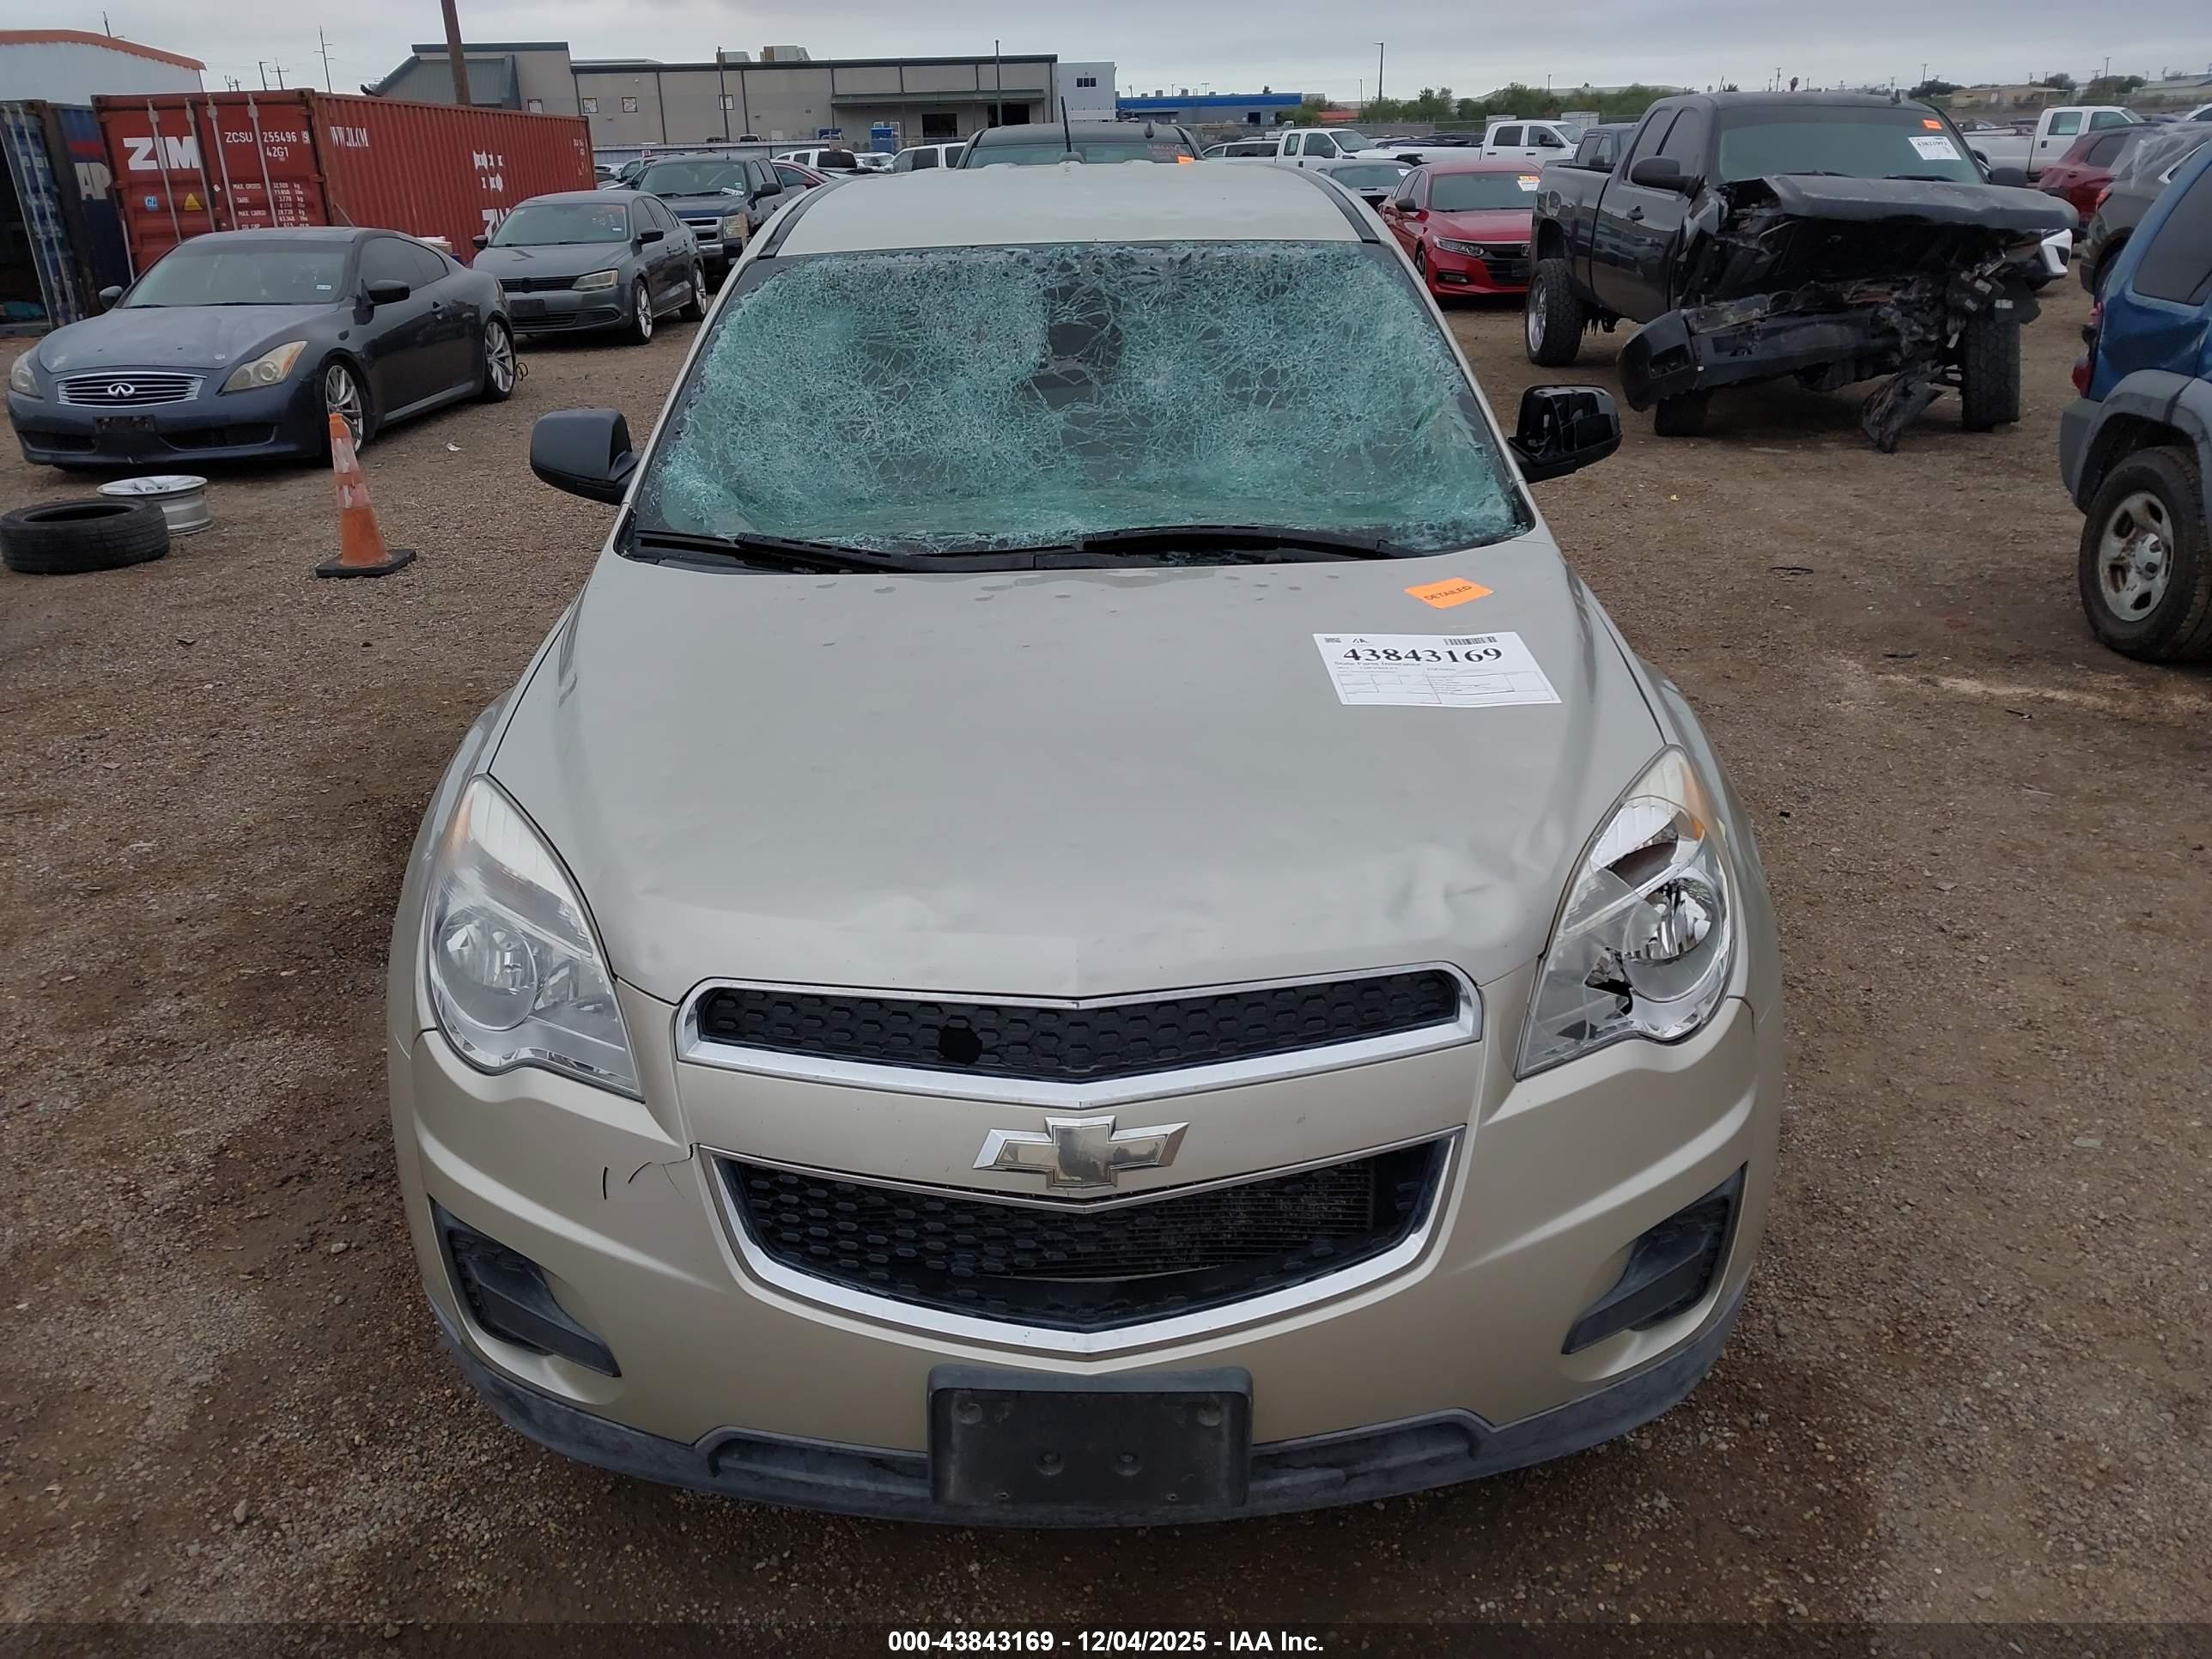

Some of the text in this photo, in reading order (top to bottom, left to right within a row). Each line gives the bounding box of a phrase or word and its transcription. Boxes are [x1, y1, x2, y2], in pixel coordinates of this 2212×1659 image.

[224, 131, 310, 144] ZCSU 255496 9
[123, 136, 201, 170] ZIM
[266, 146, 289, 157] 42G1
[1423, 585, 1473, 601] DETAILED
[1343, 647, 1503, 663] 43843169
